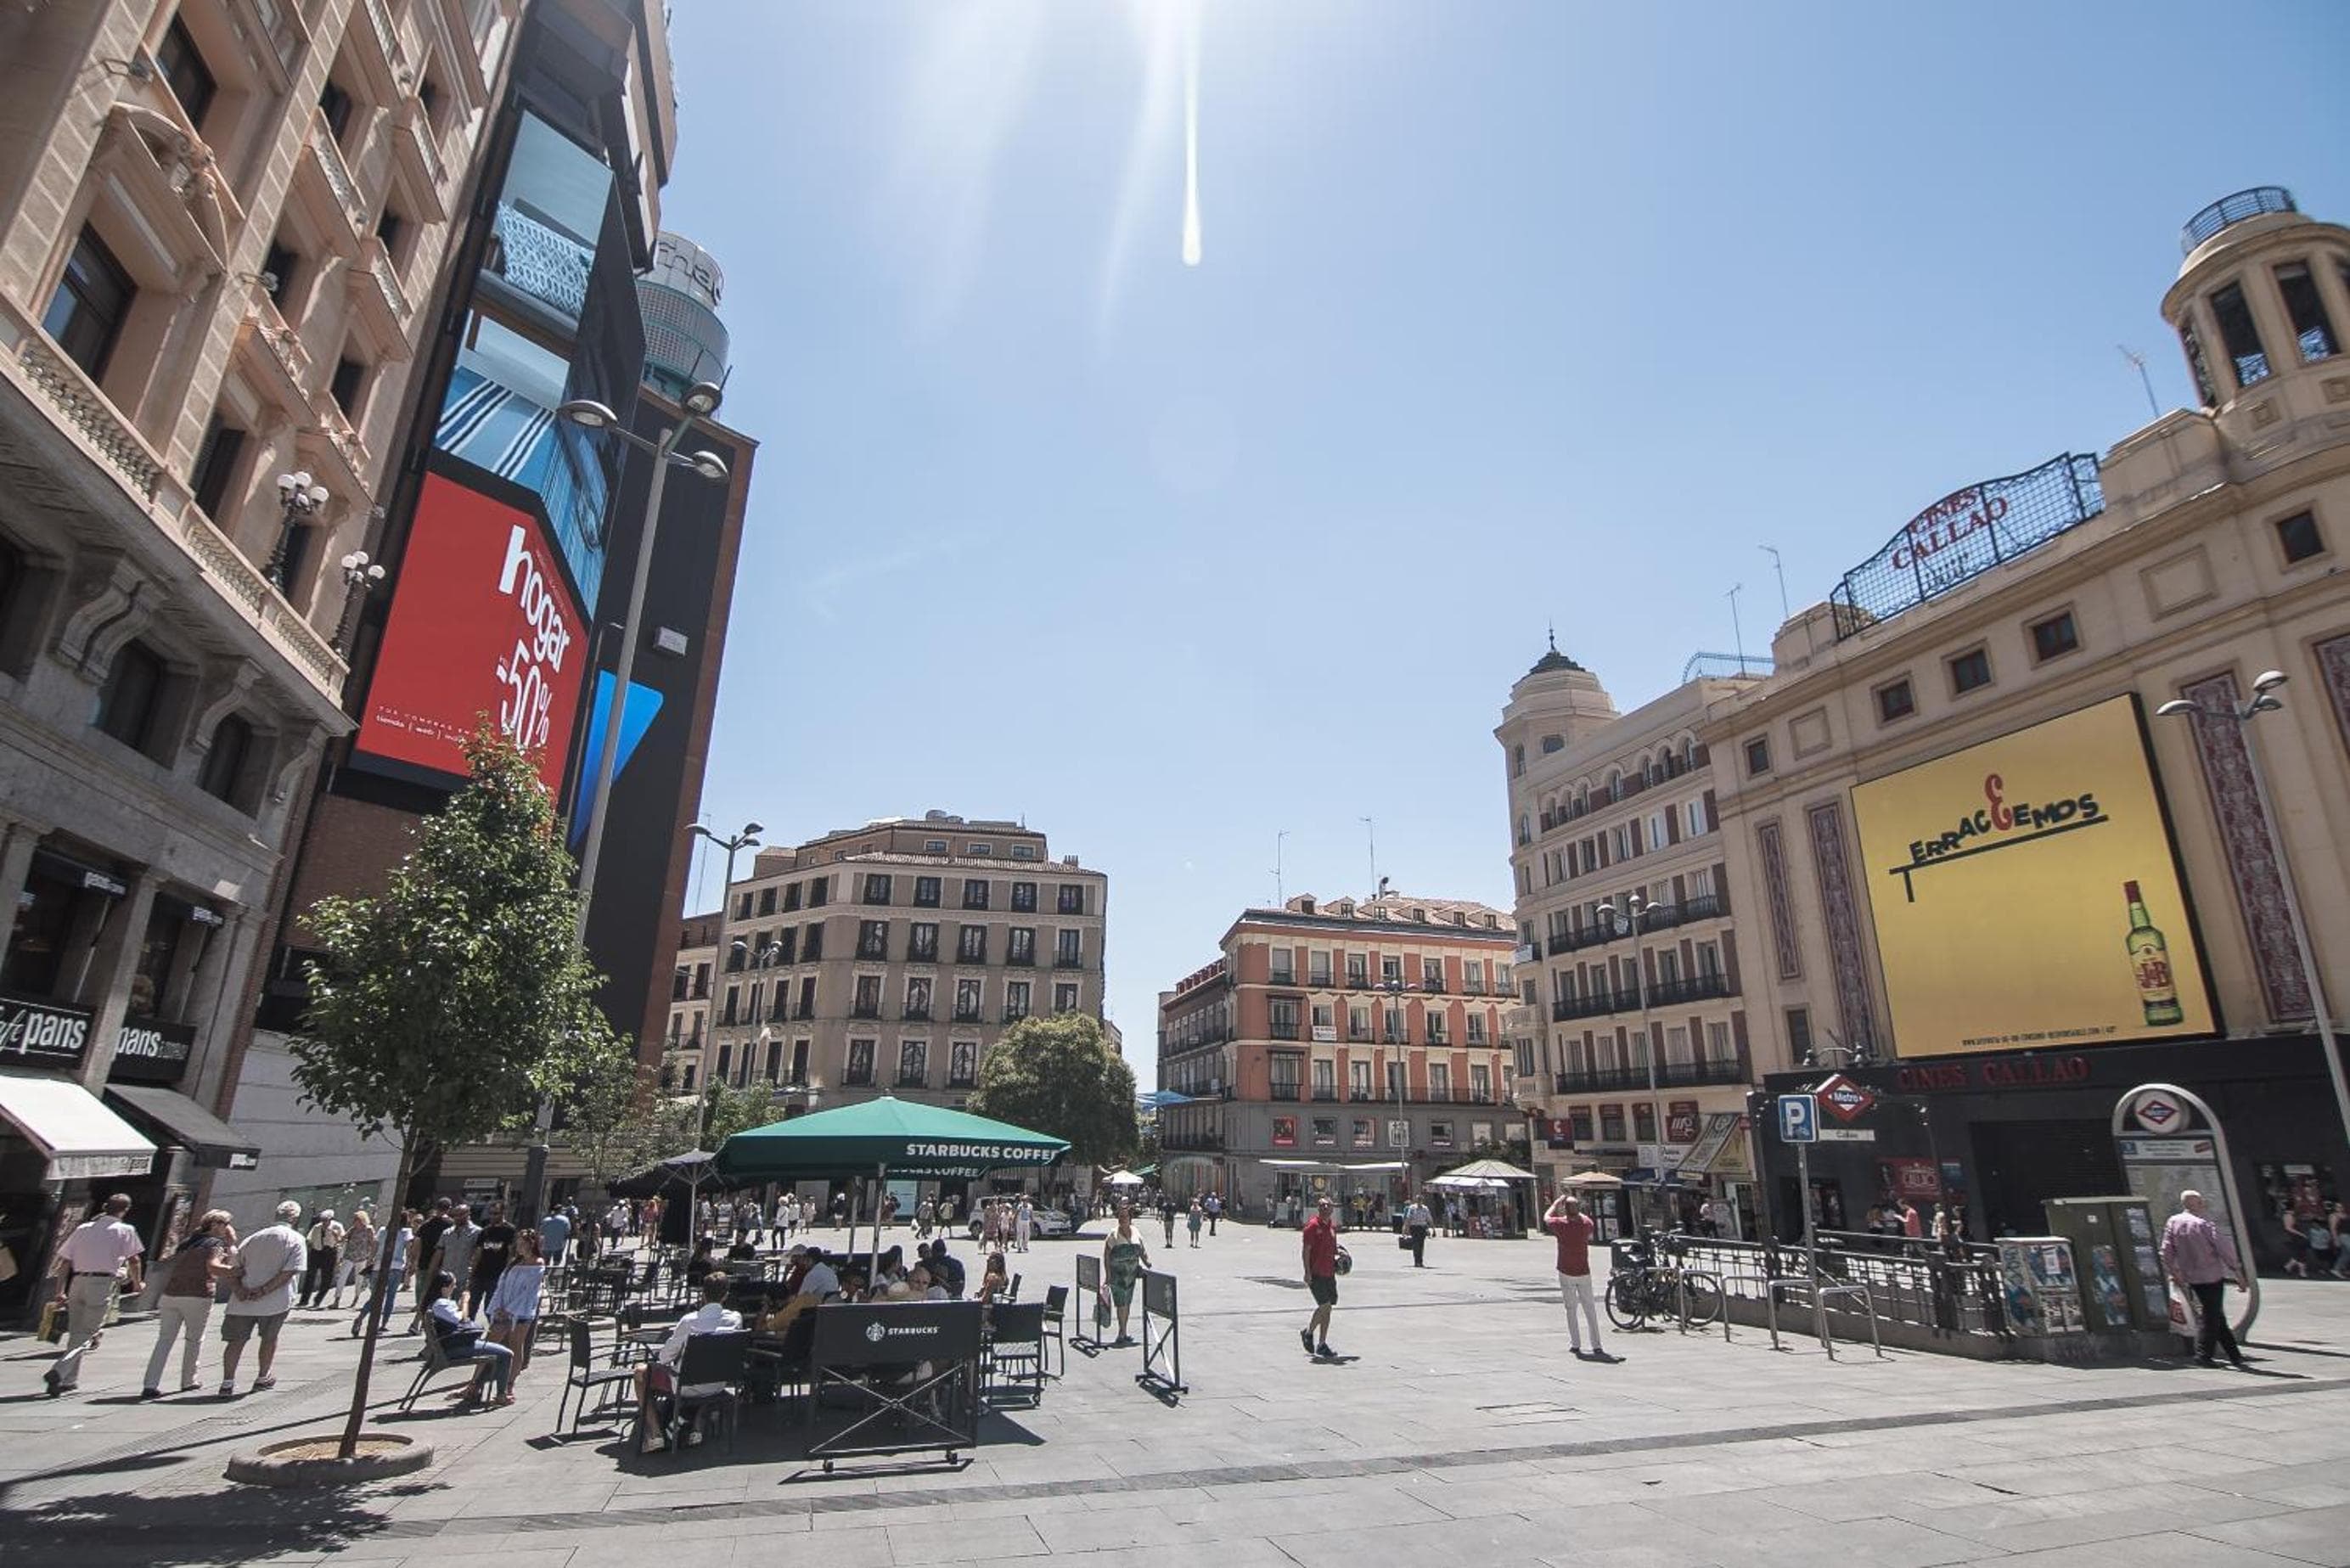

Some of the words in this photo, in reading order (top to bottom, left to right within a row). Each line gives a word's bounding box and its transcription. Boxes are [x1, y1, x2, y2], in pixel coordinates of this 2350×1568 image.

[1892, 497, 2008, 570] CALLAO
[499, 525, 571, 673] hogar
[20, 1013, 87, 1054] pans
[1897, 1066, 1967, 1092] CINES
[1982, 1059, 2090, 1086] CALLAO
[1785, 1102, 1806, 1137] P
[906, 1144, 1000, 1158] STARBUCKS
[887, 1326, 938, 1335] STARBUCKS
